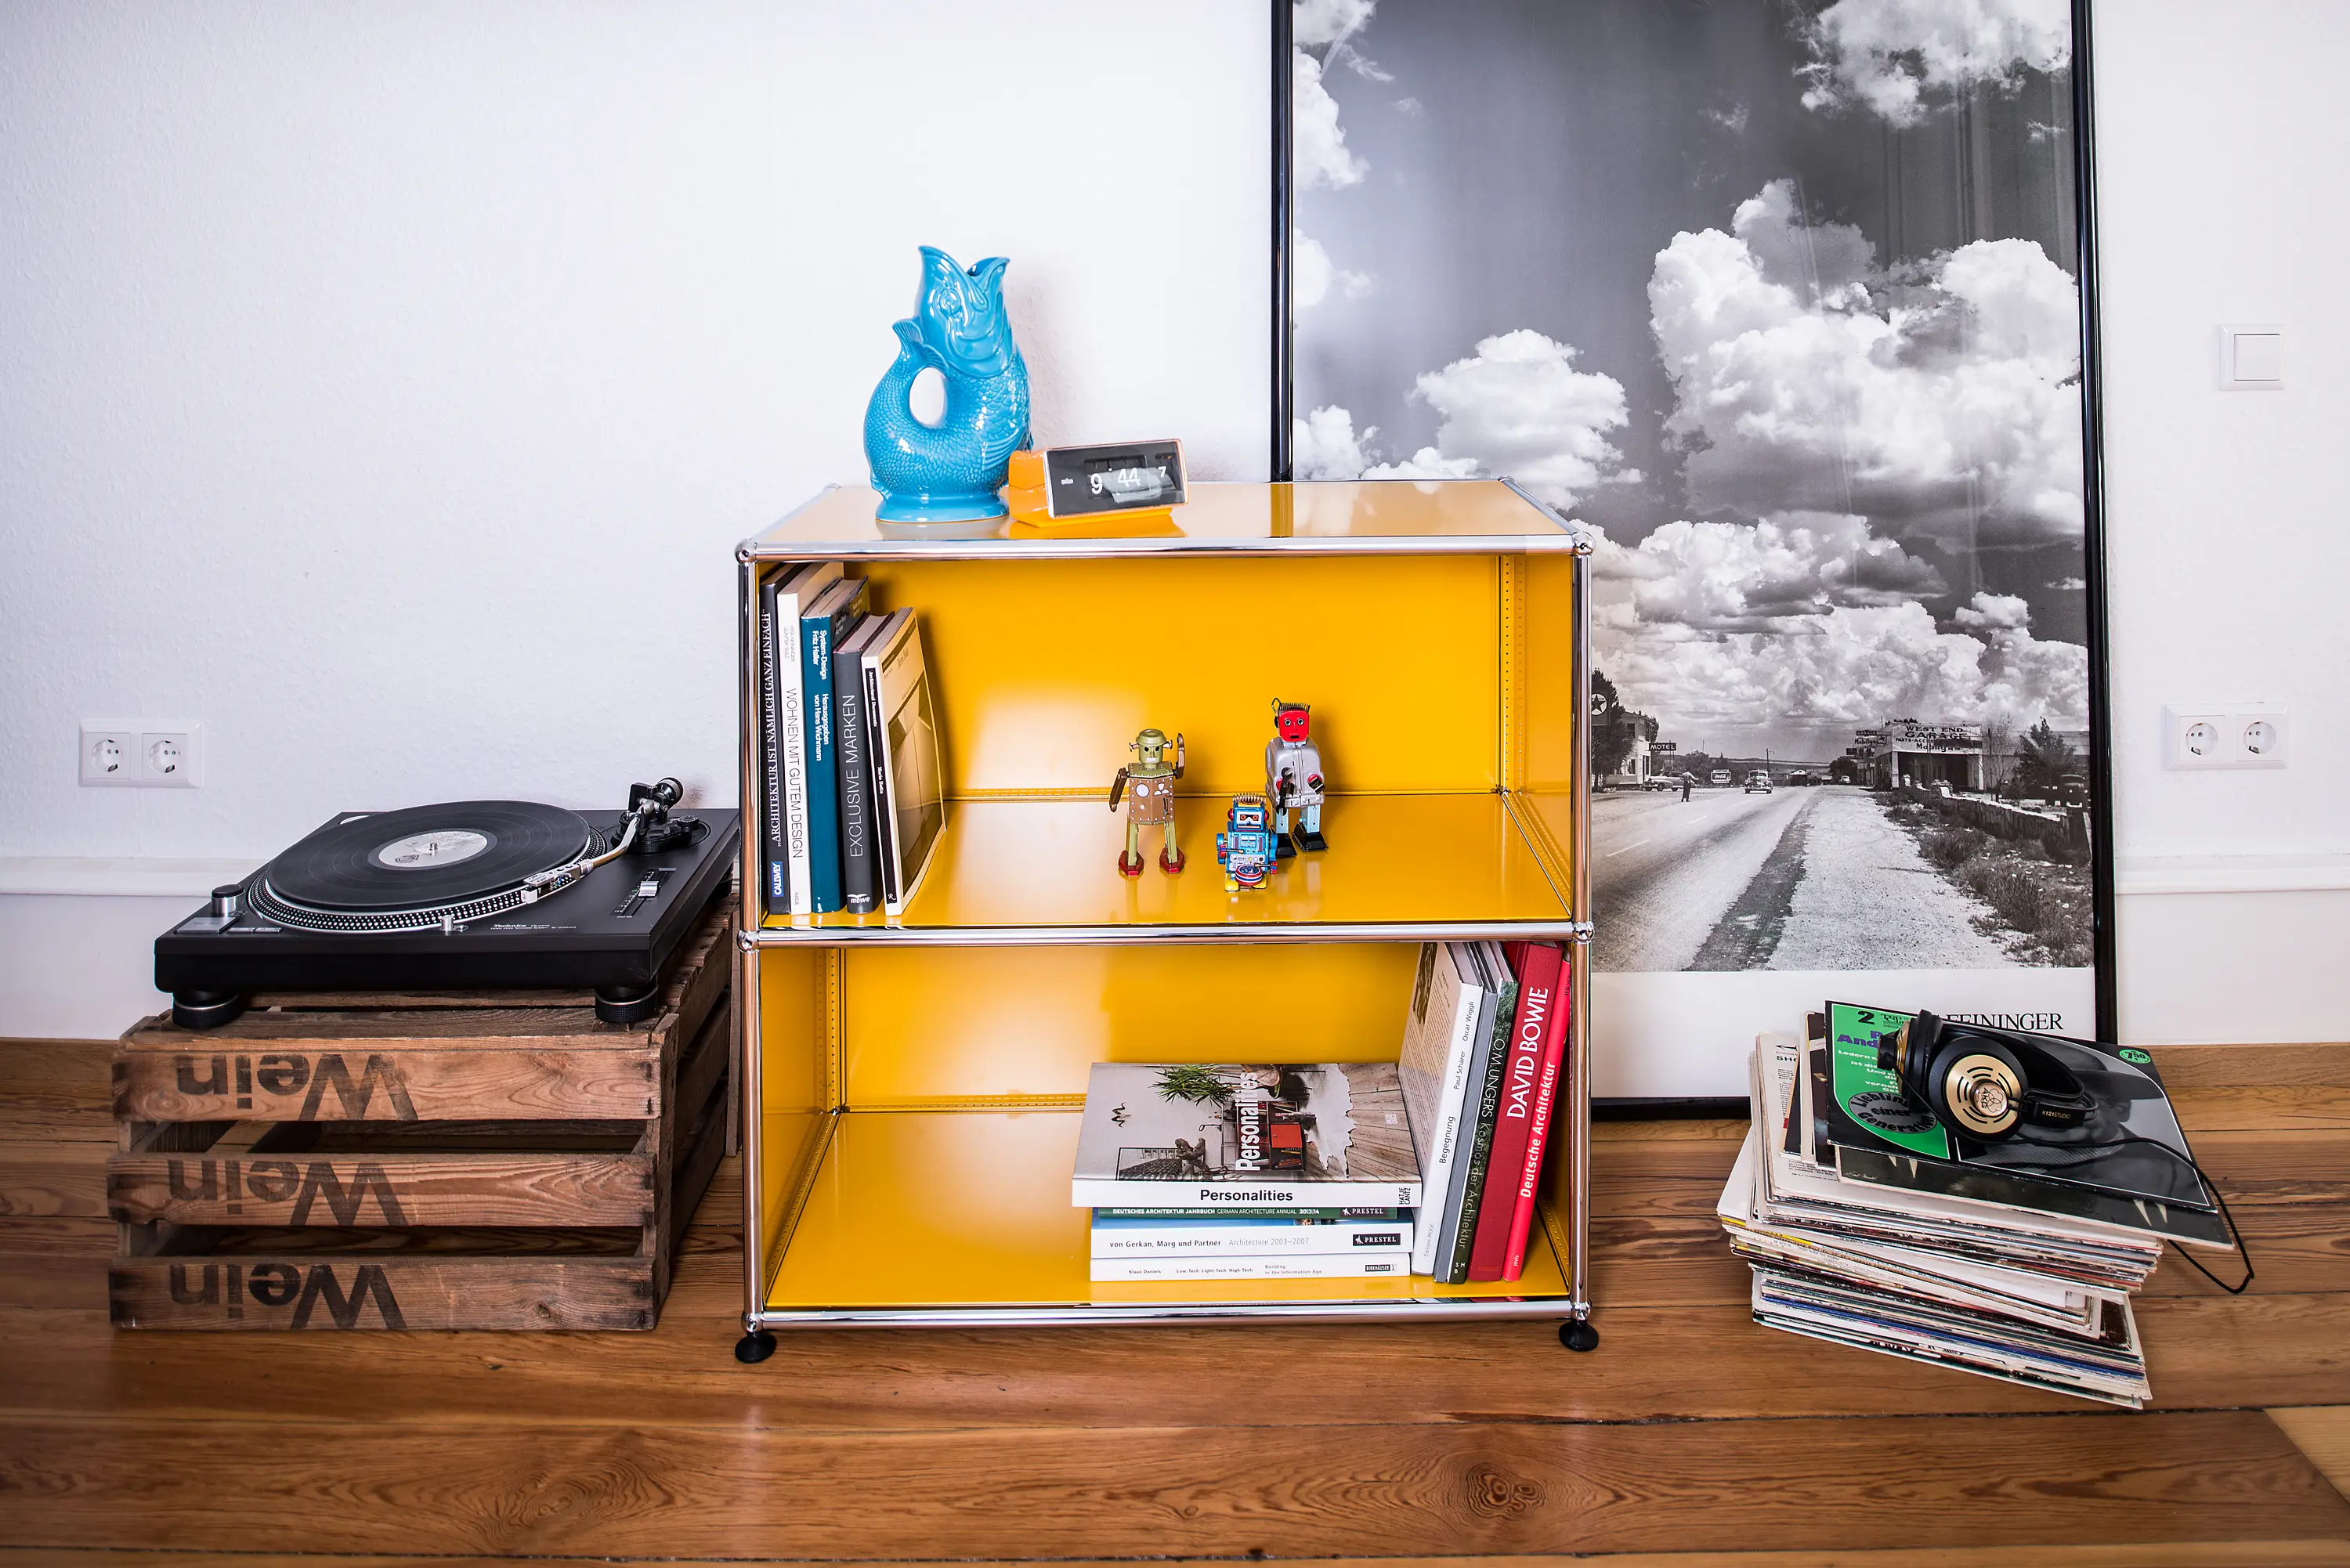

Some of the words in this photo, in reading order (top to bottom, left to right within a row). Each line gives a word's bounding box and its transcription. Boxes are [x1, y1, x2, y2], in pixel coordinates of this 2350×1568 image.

[1090, 473, 1103, 494] 9
[1118, 468, 1141, 486] 44
[764, 661, 775, 691] GANZ
[765, 693, 777, 743] NÄMLICH
[786, 688, 799, 744] WOHNEN
[822, 693, 830, 745] Herausgegeben
[843, 694, 859, 764] MARKEN
[768, 747, 777, 764] IST
[788, 746, 800, 765] MIT
[790, 768, 801, 811] GUTEM
[846, 768, 863, 858] EXCLUSIVE
[791, 813, 803, 858] DESIGN
[1456, 1050, 1466, 1074] Schärer
[1466, 1001, 1474, 1021] Wiggli
[1519, 986, 1549, 1053] BOWIE
[1837, 1034, 1879, 1048] And
[1857, 1010, 1875, 1025] 2
[176, 1053, 418, 1122] Wein
[1506, 1055, 1535, 1119] DAVID
[1235, 1071, 1260, 1172] Personalities
[1439, 1115, 1456, 1164] Begegnung
[1473, 1122, 1491, 1165] Kosmos
[1520, 1138, 1542, 1198] Deutsche
[1532, 1061, 1556, 1136] Architektur
[1857, 1112, 1936, 1133] Generation
[169, 1159, 409, 1227] Wein
[1200, 1188, 1293, 1201] Personalities
[1470, 1167, 1483, 1187] der
[1459, 1190, 1477, 1249] Architektur
[170, 1263, 408, 1330] Wein
